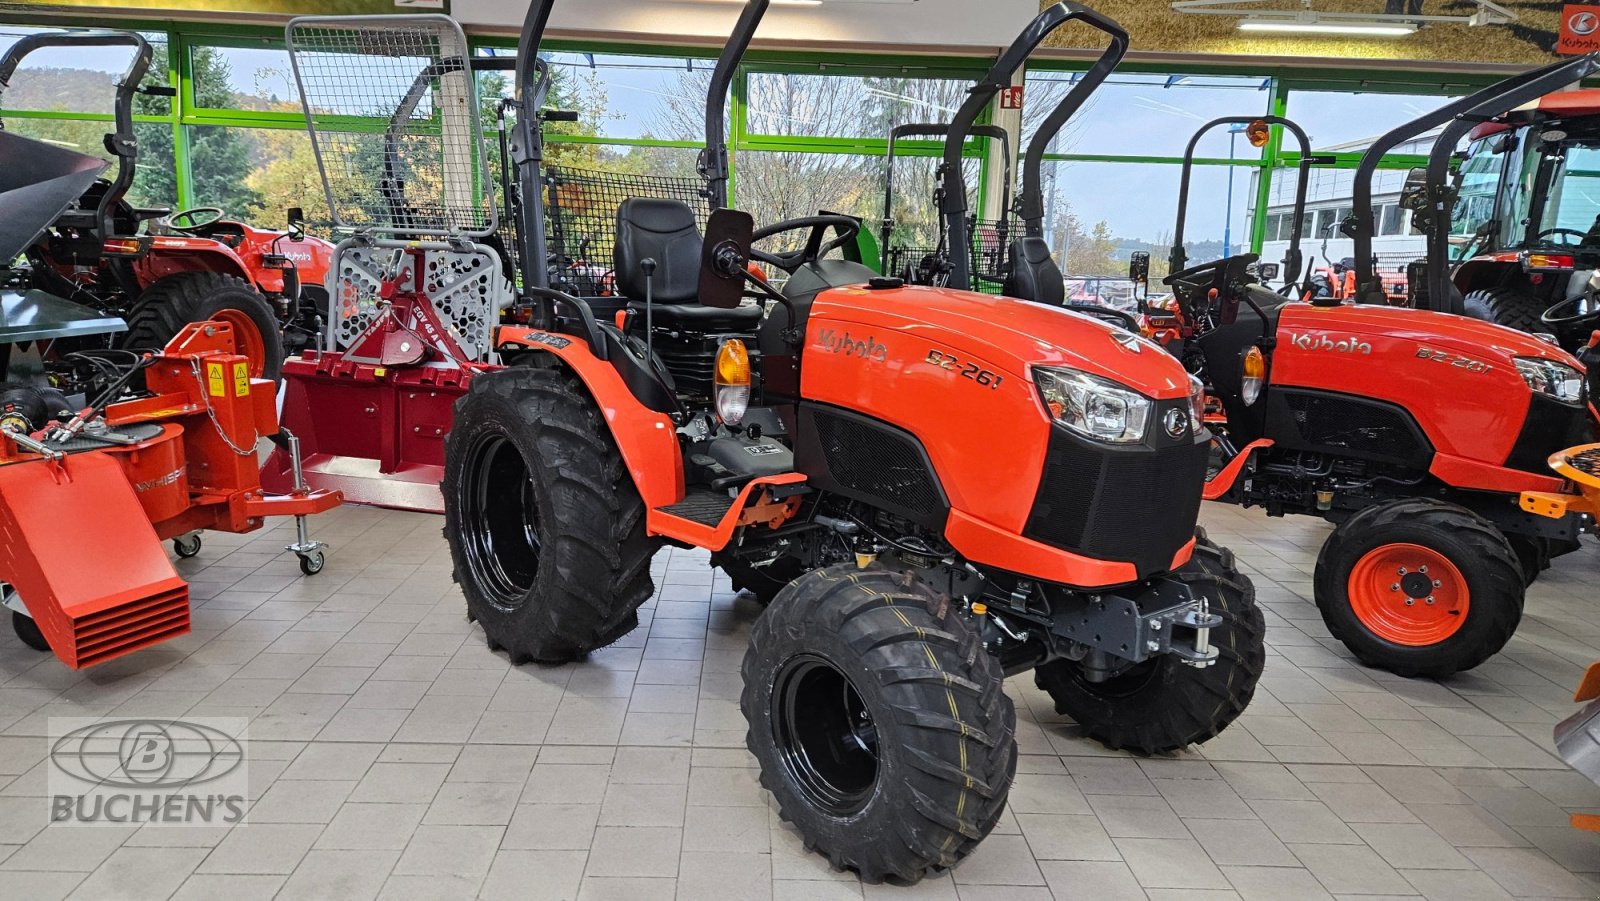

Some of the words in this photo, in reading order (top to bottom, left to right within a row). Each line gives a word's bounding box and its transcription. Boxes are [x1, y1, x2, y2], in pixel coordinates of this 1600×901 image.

[1562, 37, 1599, 49] Kubota
[413, 306, 428, 323] EGV
[424, 323, 435, 334] 45
[430, 333, 439, 341] A
[818, 327, 888, 362] Kubota
[1290, 332, 1372, 355] Kubota
[925, 348, 1004, 390] B2-261
[1415, 346, 1493, 374] B2-201
